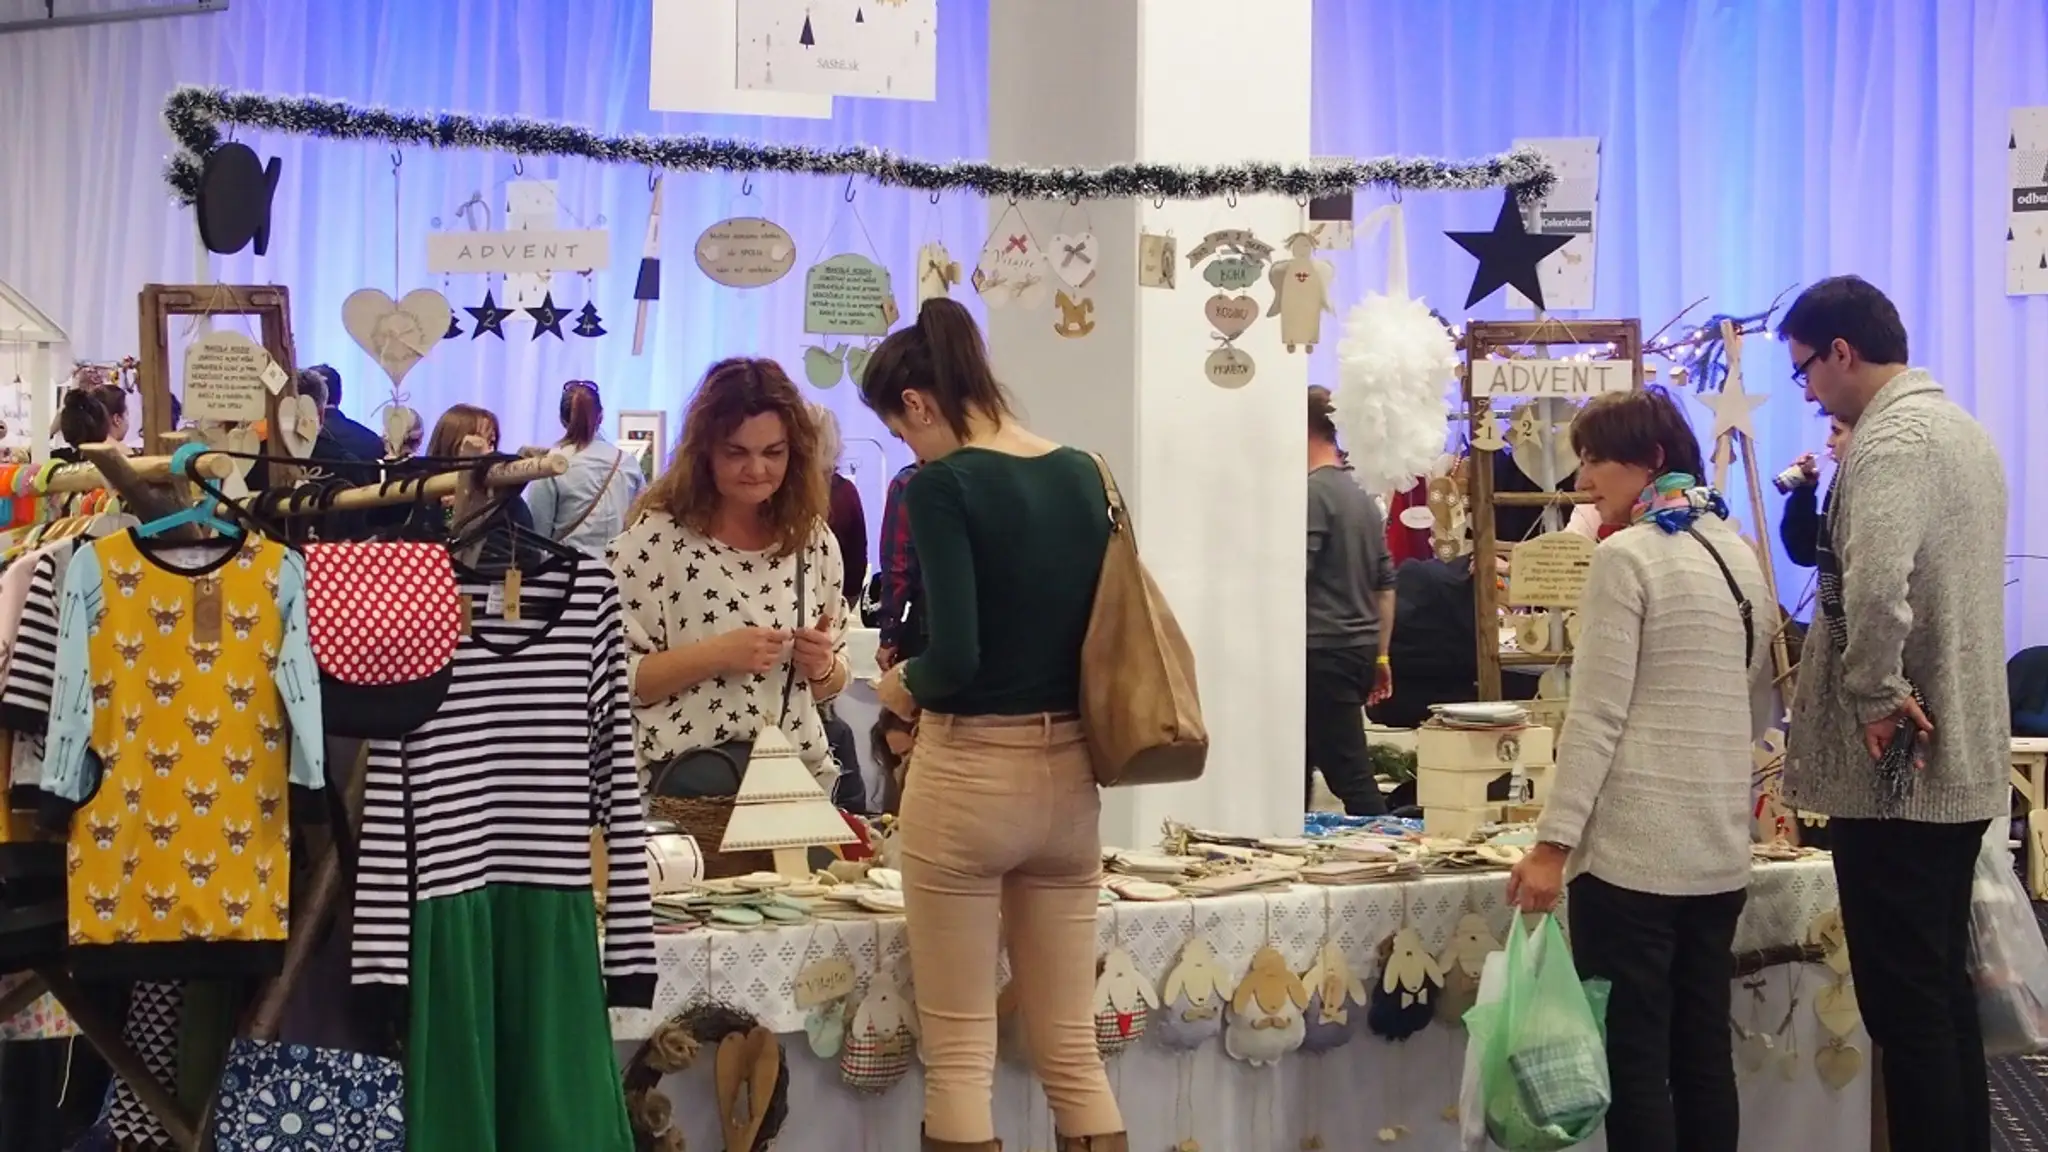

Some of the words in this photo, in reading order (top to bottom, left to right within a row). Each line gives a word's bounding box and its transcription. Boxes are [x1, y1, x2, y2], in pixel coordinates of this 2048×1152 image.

[458, 244, 579, 259] ADVENT
[483, 310, 496, 327] 2
[543, 308, 554, 326] 3
[583, 316, 595, 335] 4
[1489, 366, 1613, 392] ADVENT
[1487, 426, 1492, 440] 1
[1522, 420, 1532, 436] 2
